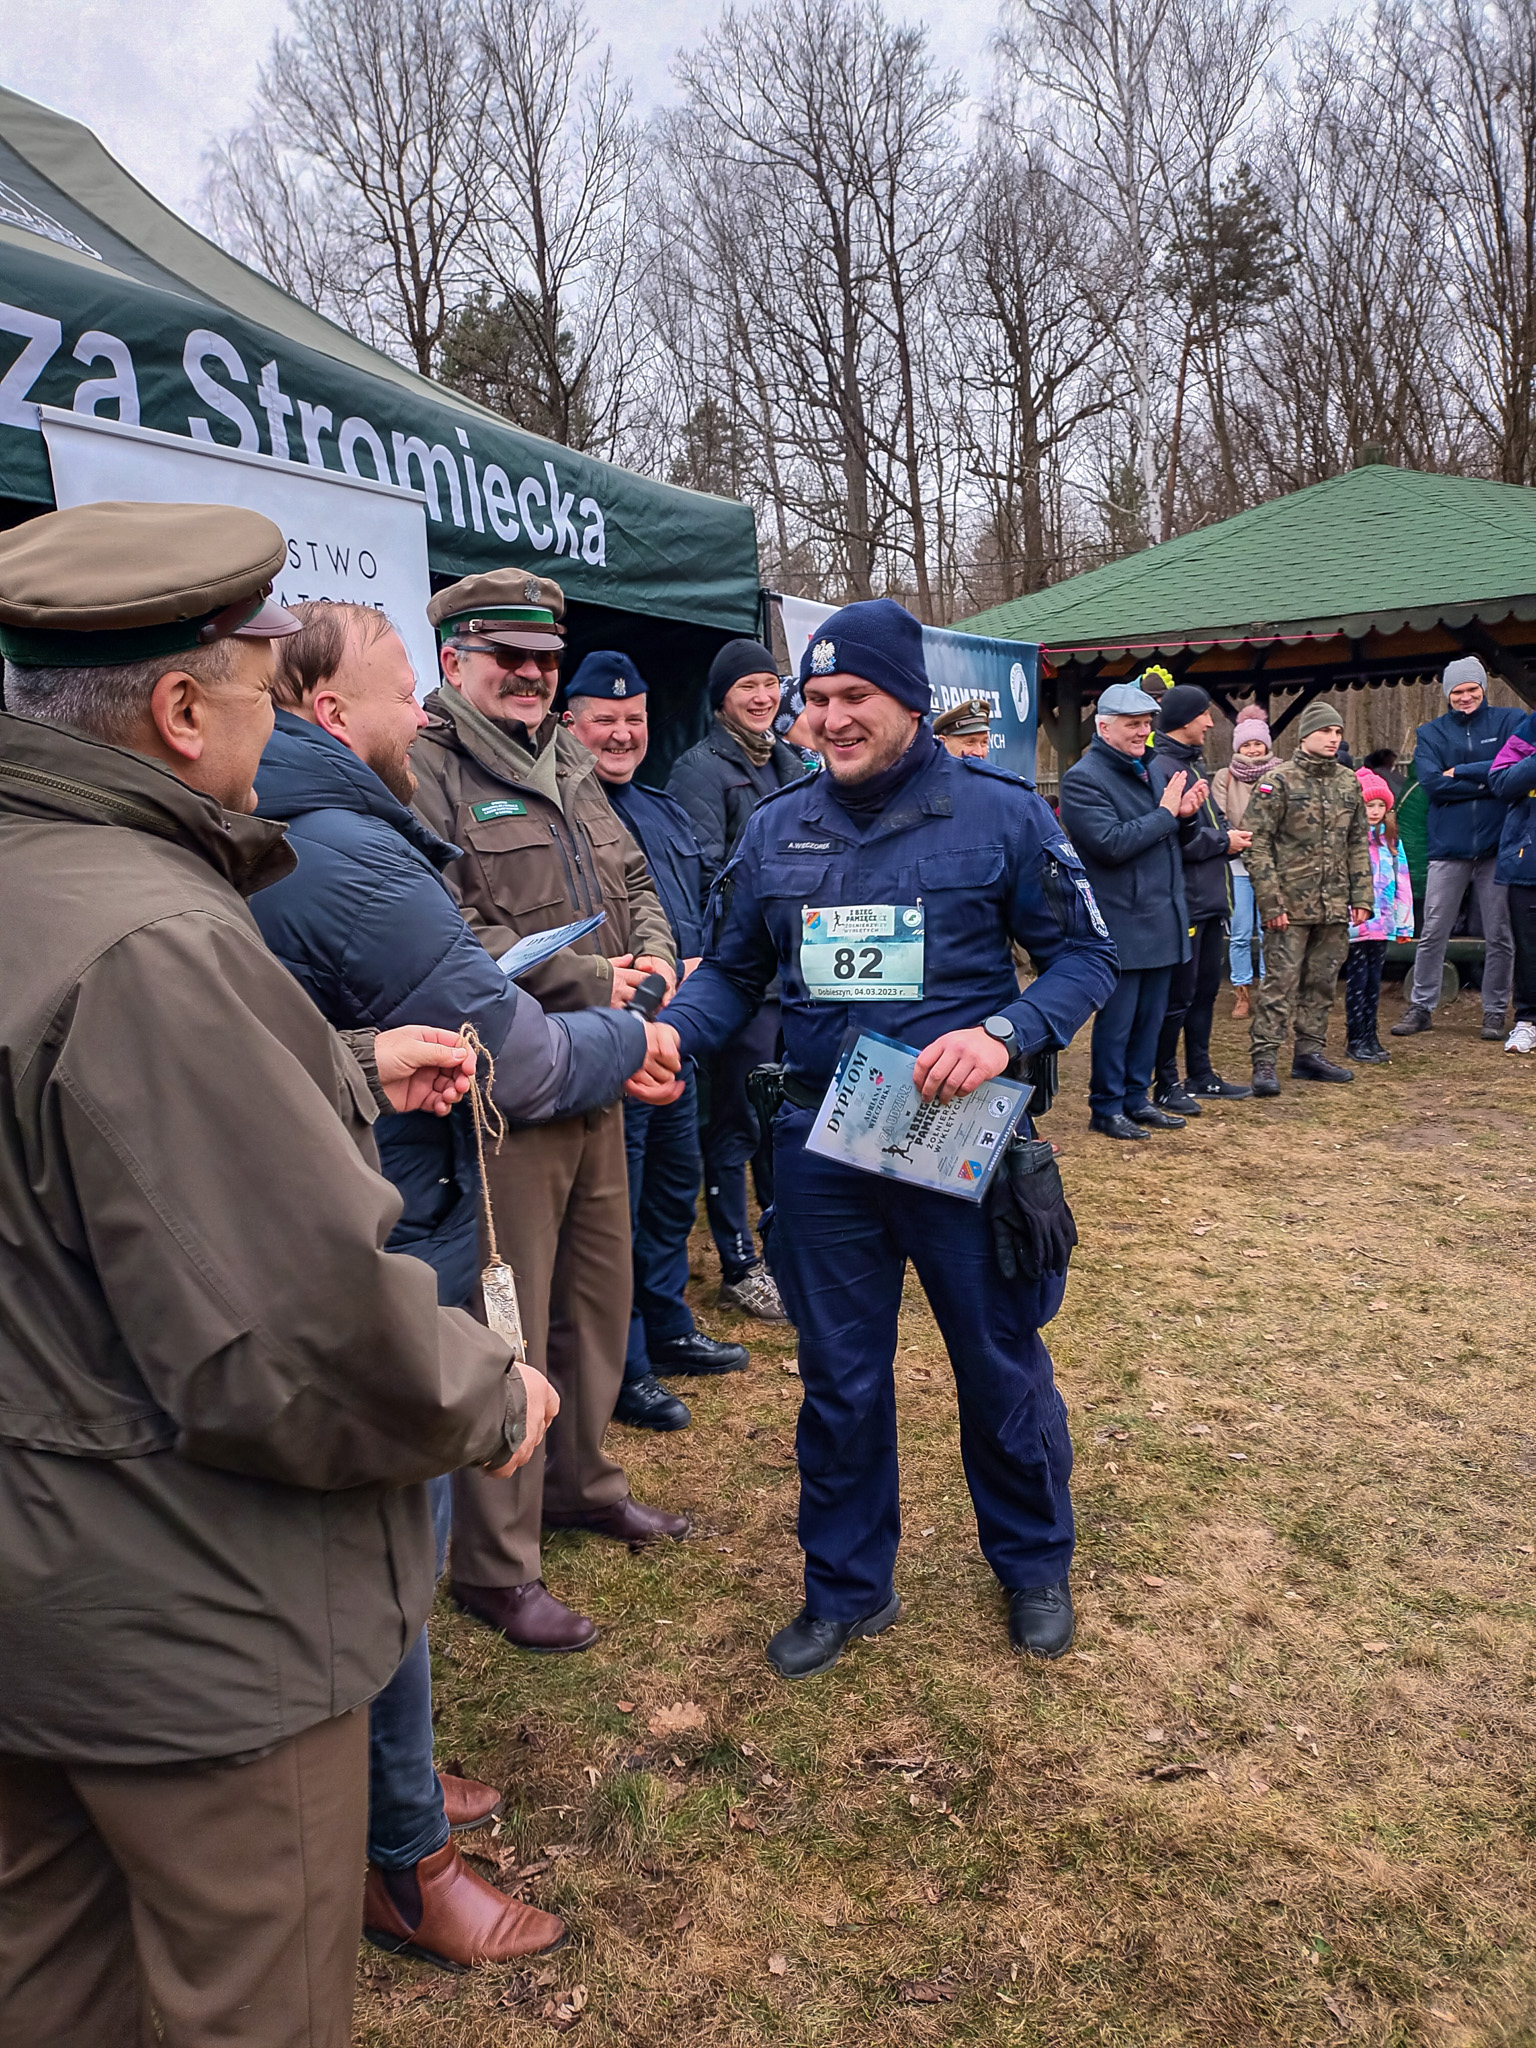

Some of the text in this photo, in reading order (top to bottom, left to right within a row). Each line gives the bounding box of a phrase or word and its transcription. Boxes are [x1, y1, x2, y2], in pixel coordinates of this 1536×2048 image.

[182, 328, 607, 567] Stromiecka
[834, 948, 883, 979] 82
[817, 988, 853, 997] Dobieszyn,
[826, 1050, 868, 1133] DYPLOM
[863, 1086, 882, 1121] ADRIANA
[868, 1083, 891, 1129] WIECZORKA
[878, 1084, 912, 1141] ZA UDZIAŁ
[909, 1102, 930, 1131] BIEG
[933, 1097, 963, 1153] WYKLĘTYCH
